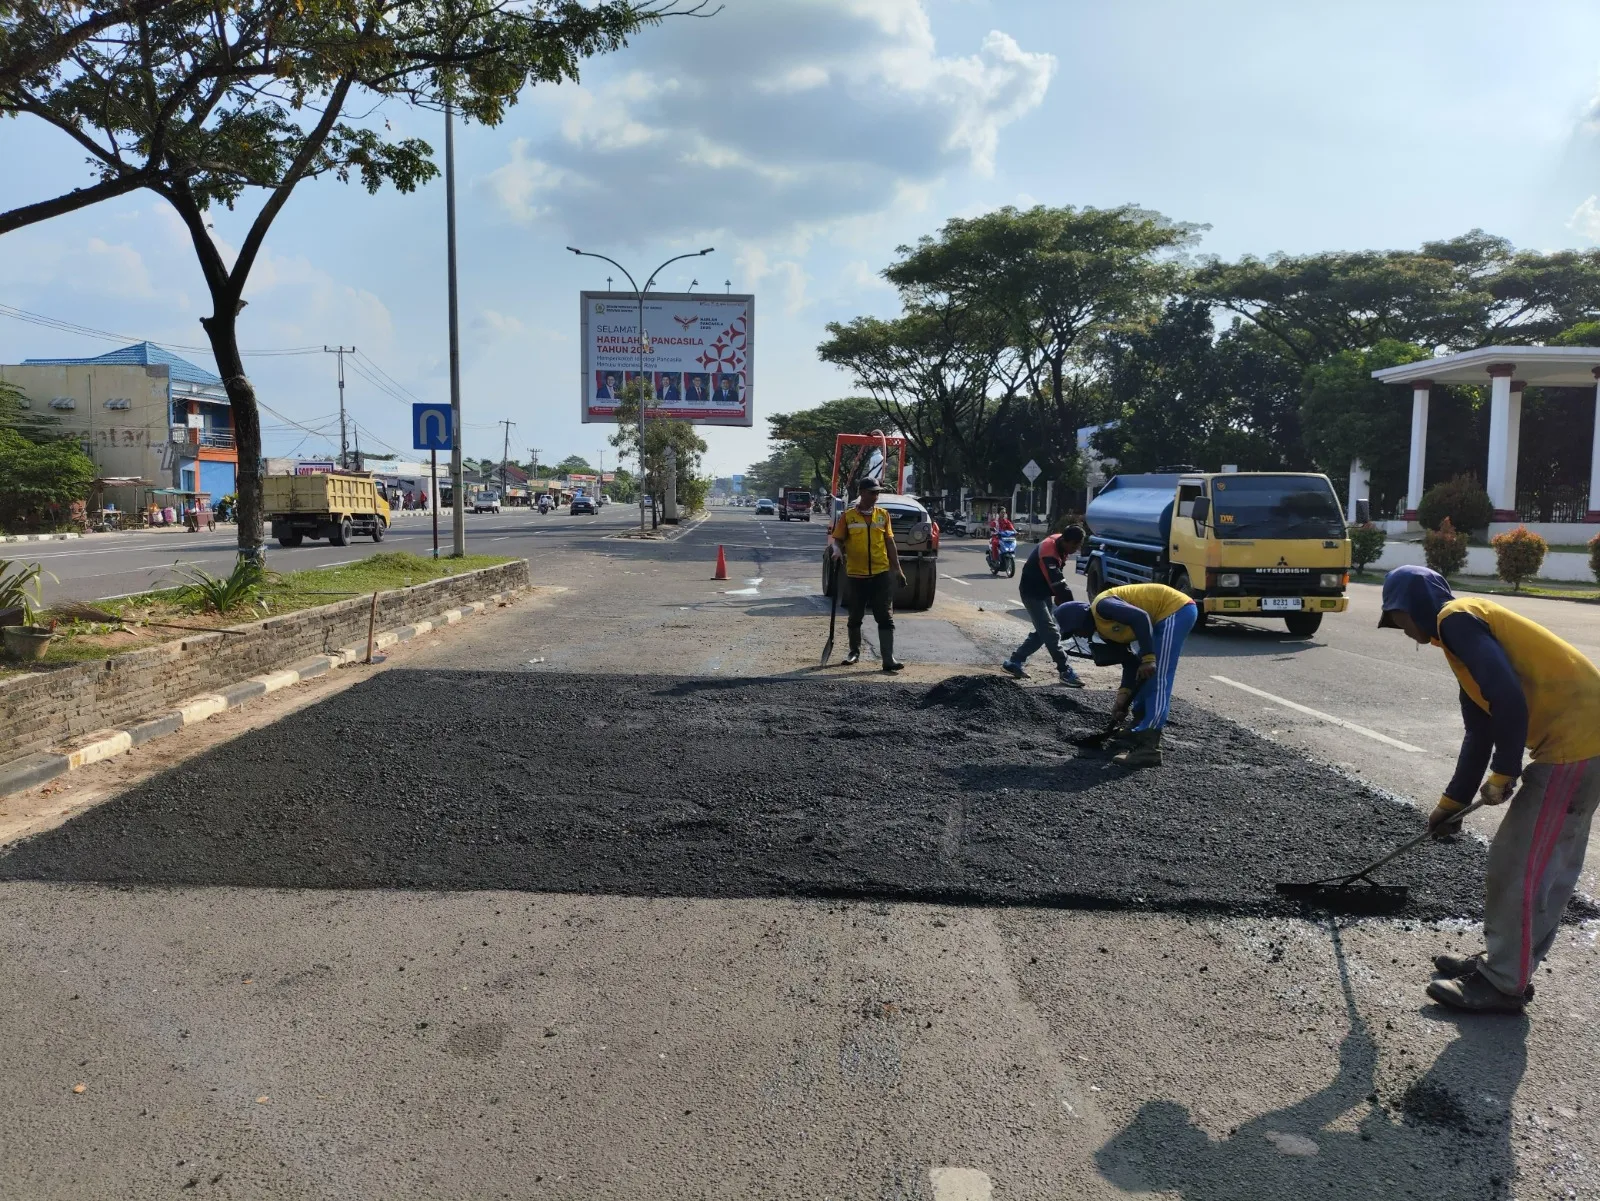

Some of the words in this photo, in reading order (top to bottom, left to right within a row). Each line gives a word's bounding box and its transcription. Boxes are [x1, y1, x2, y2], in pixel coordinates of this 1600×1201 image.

[597, 325, 637, 334] SELAMAT
[597, 335, 619, 344] HARI
[621, 336, 647, 345] LAH
[651, 337, 704, 346] PANCASILA
[597, 345, 628, 354] TAHUN
